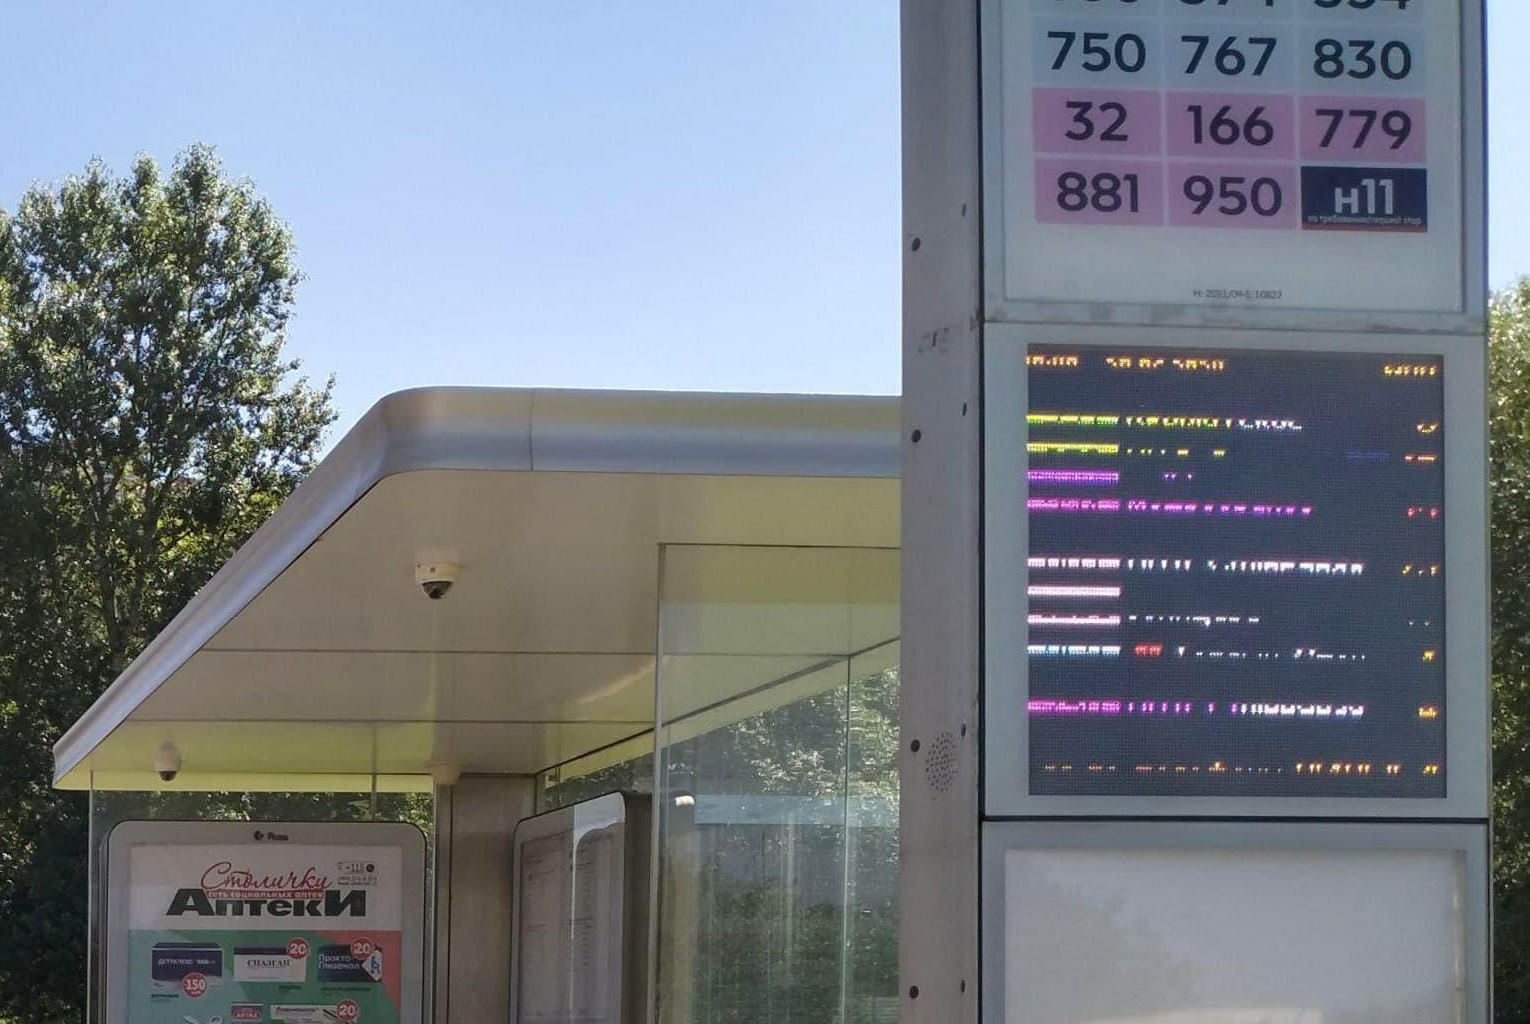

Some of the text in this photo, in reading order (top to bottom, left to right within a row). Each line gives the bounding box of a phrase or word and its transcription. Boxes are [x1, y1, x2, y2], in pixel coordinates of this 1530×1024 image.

[1047, 31, 1146, 73] 750
[1181, 35, 1277, 77] 767
[1313, 38, 1412, 80] 830
[1064, 101, 1129, 143] 32
[1187, 104, 1274, 146] 166
[1315, 109, 1412, 150] 779
[1056, 171, 1139, 214] 881
[1183, 175, 1282, 217] 950
[201, 861, 332, 891] Столички
